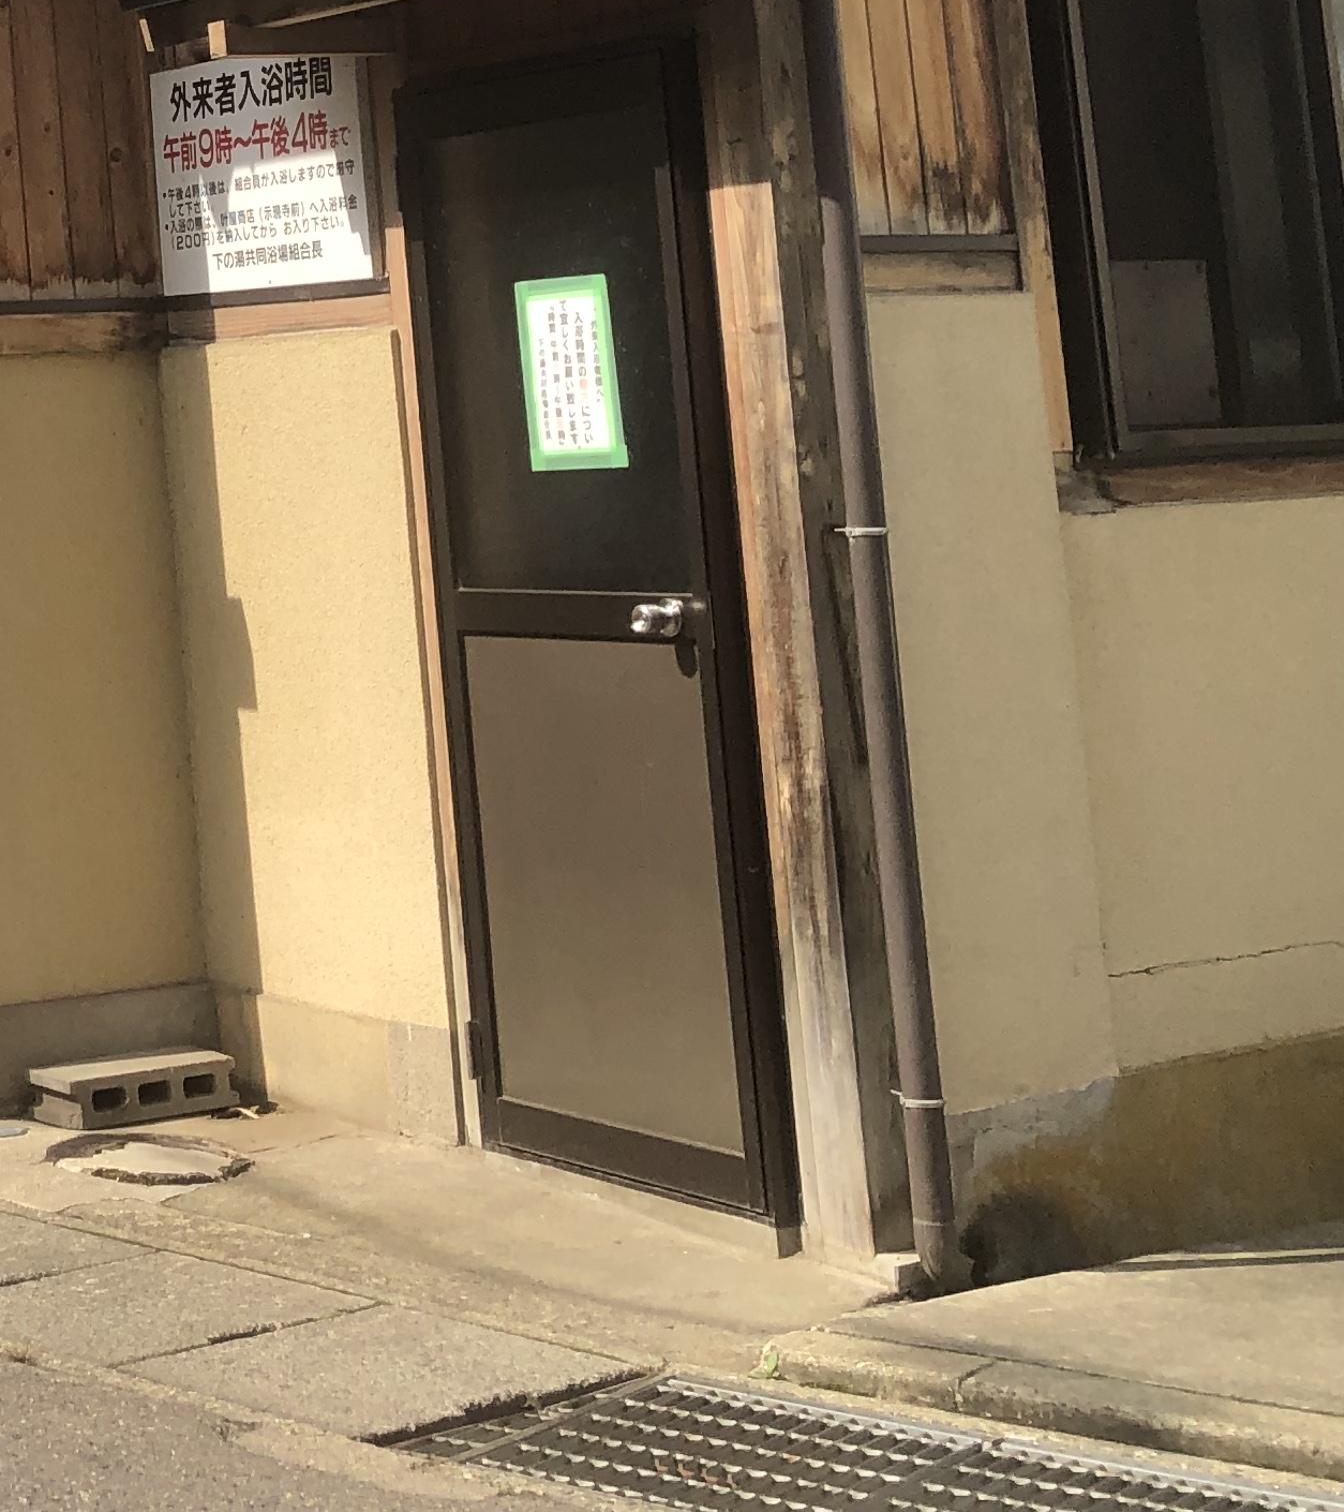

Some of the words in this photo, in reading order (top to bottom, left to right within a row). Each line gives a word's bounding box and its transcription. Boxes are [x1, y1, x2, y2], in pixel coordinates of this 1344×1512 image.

[170, 57, 332, 123] 外来者入浴時間
